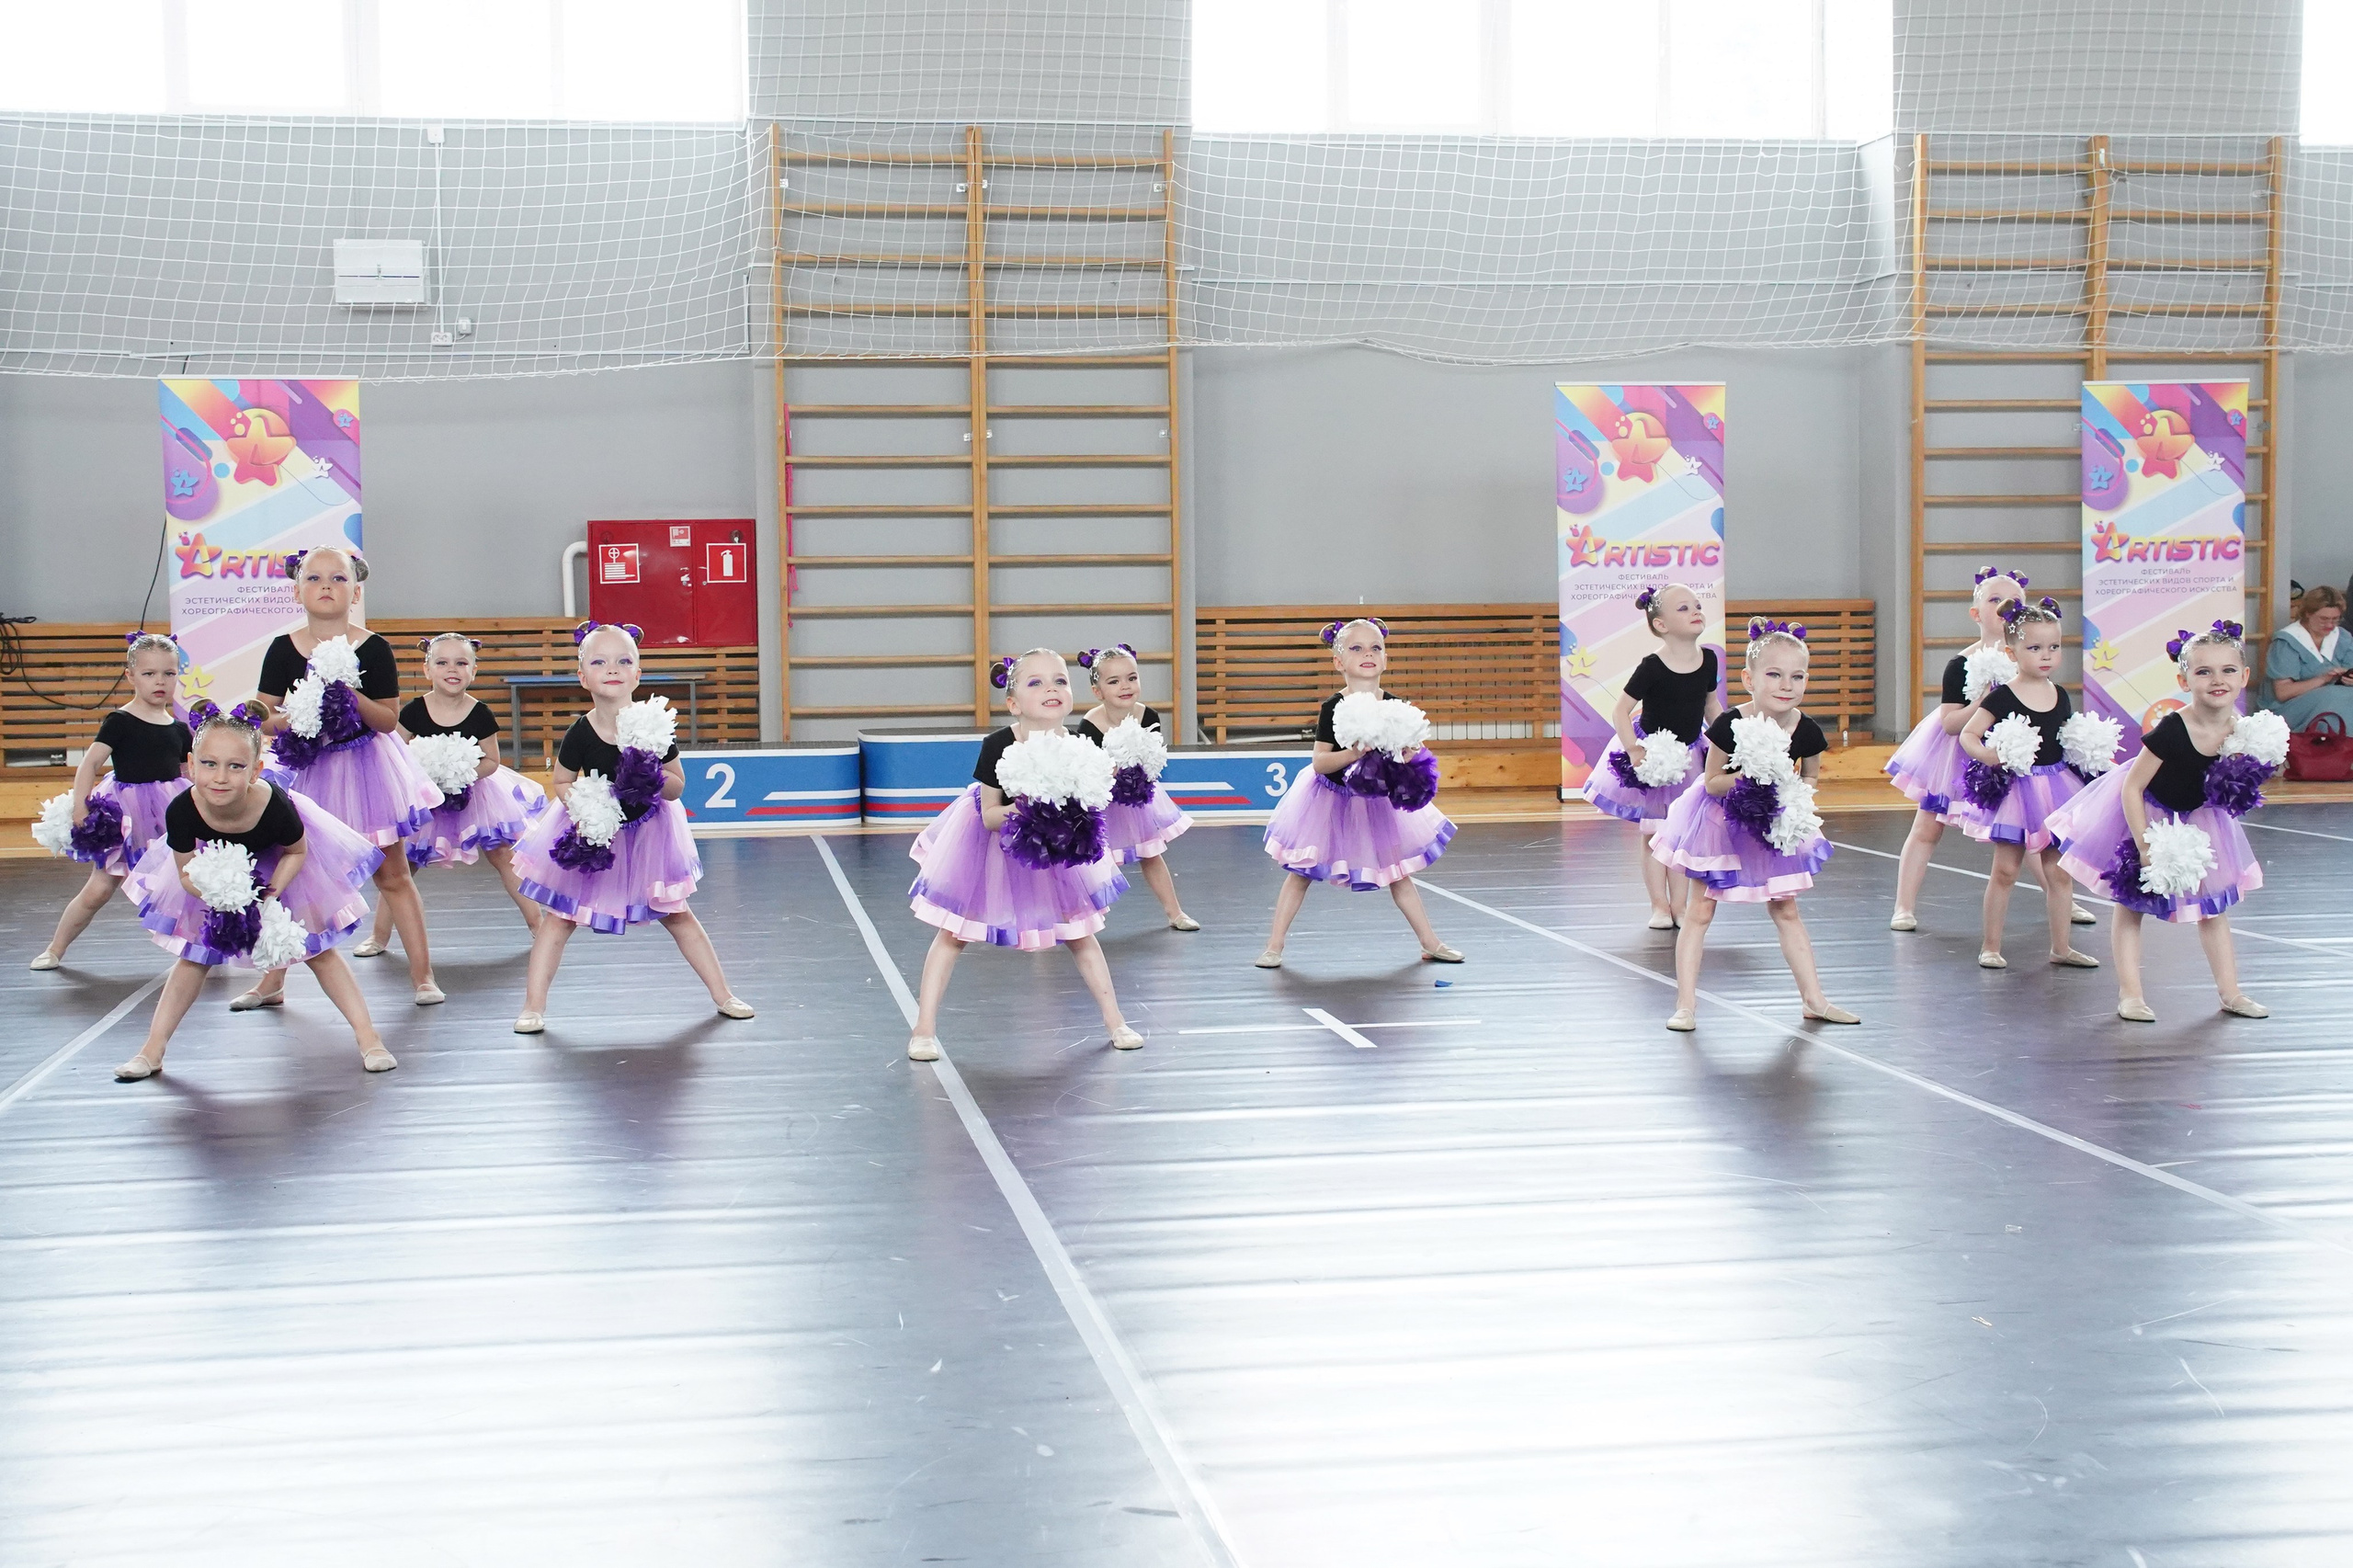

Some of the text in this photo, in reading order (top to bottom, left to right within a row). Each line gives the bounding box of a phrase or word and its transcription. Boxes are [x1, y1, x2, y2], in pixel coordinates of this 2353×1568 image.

[176, 532, 300, 579] ARTIS
[1565, 525, 1721, 568] ARTISTIC
[2091, 521, 2241, 562] ARTISTIC
[2096, 585, 2237, 596] ХОРЕОГРАФИЧЕСКОГО ИСКУССТВА
[2098, 578, 2160, 586] ЭСТЕТИЧЕСКИХ
[2162, 577, 2191, 585] ВИДОВ
[181, 607, 294, 616] ХОРЕОГРАФИЧЕСКОГО
[185, 597, 261, 605] ЭСТЕТИЧЕСКИХ
[705, 762, 736, 809] 2
[1265, 762, 1288, 798] 3
